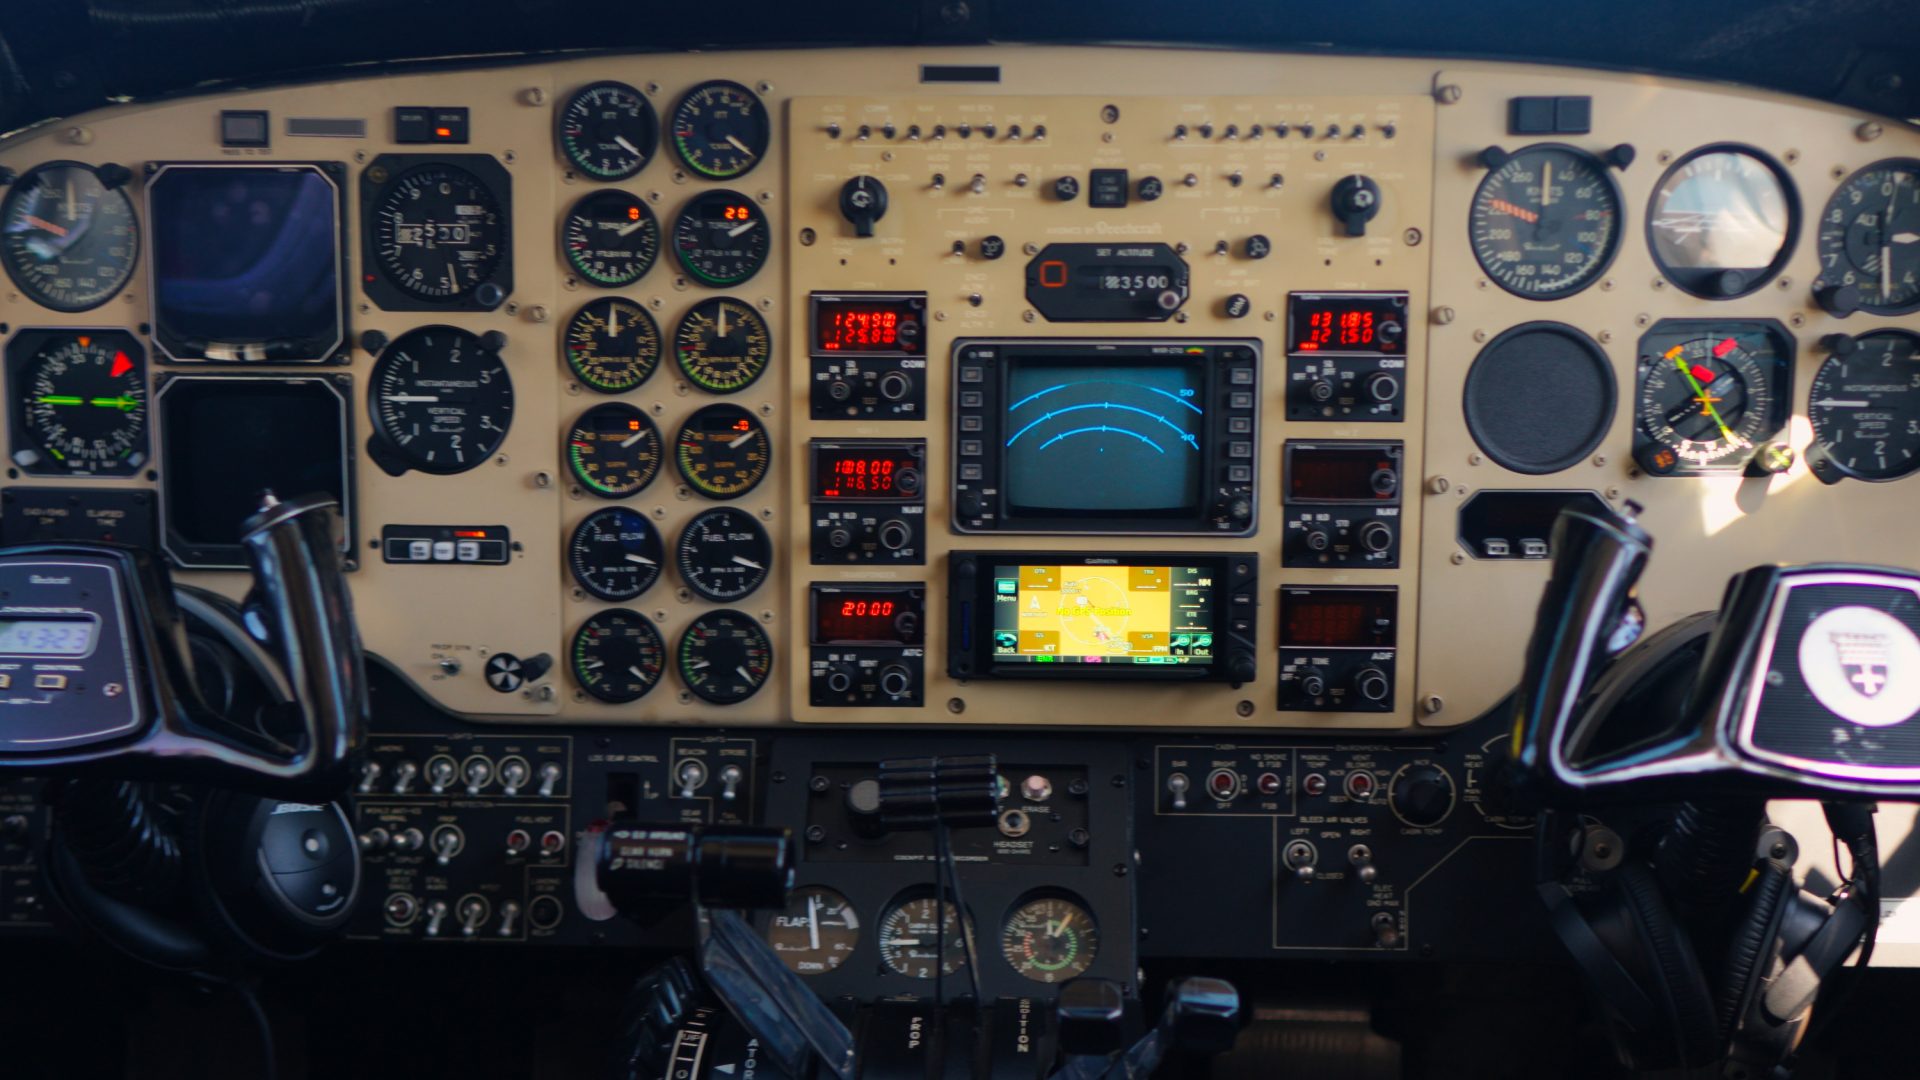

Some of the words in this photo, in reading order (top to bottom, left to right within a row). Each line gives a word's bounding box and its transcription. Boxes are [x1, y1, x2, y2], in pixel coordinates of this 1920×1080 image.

[450, 349, 461, 363] 2
[1882, 352, 1893, 366] 2
[480, 370, 491, 384] 3
[480, 415, 491, 429] 3
[1907, 420, 1918, 434] 3
[450, 434, 461, 448] 2
[1874, 441, 1885, 455] 2
[594, 533, 618, 542] FUEL
[619, 532, 645, 540] FLOW
[702, 534, 725, 542] FUEL
[728, 533, 753, 541] FLOW
[1198, 578, 1212, 587] NM
[996, 594, 1017, 602] Menu
[842, 602, 893, 616] 2000
[1056, 607, 1071, 616] No
[997, 646, 1016, 654] Back
[1175, 648, 1184, 656] In
[1194, 648, 1209, 656] Out
[919, 967, 928, 977] 2
[908, 1016, 923, 1049] PROP
